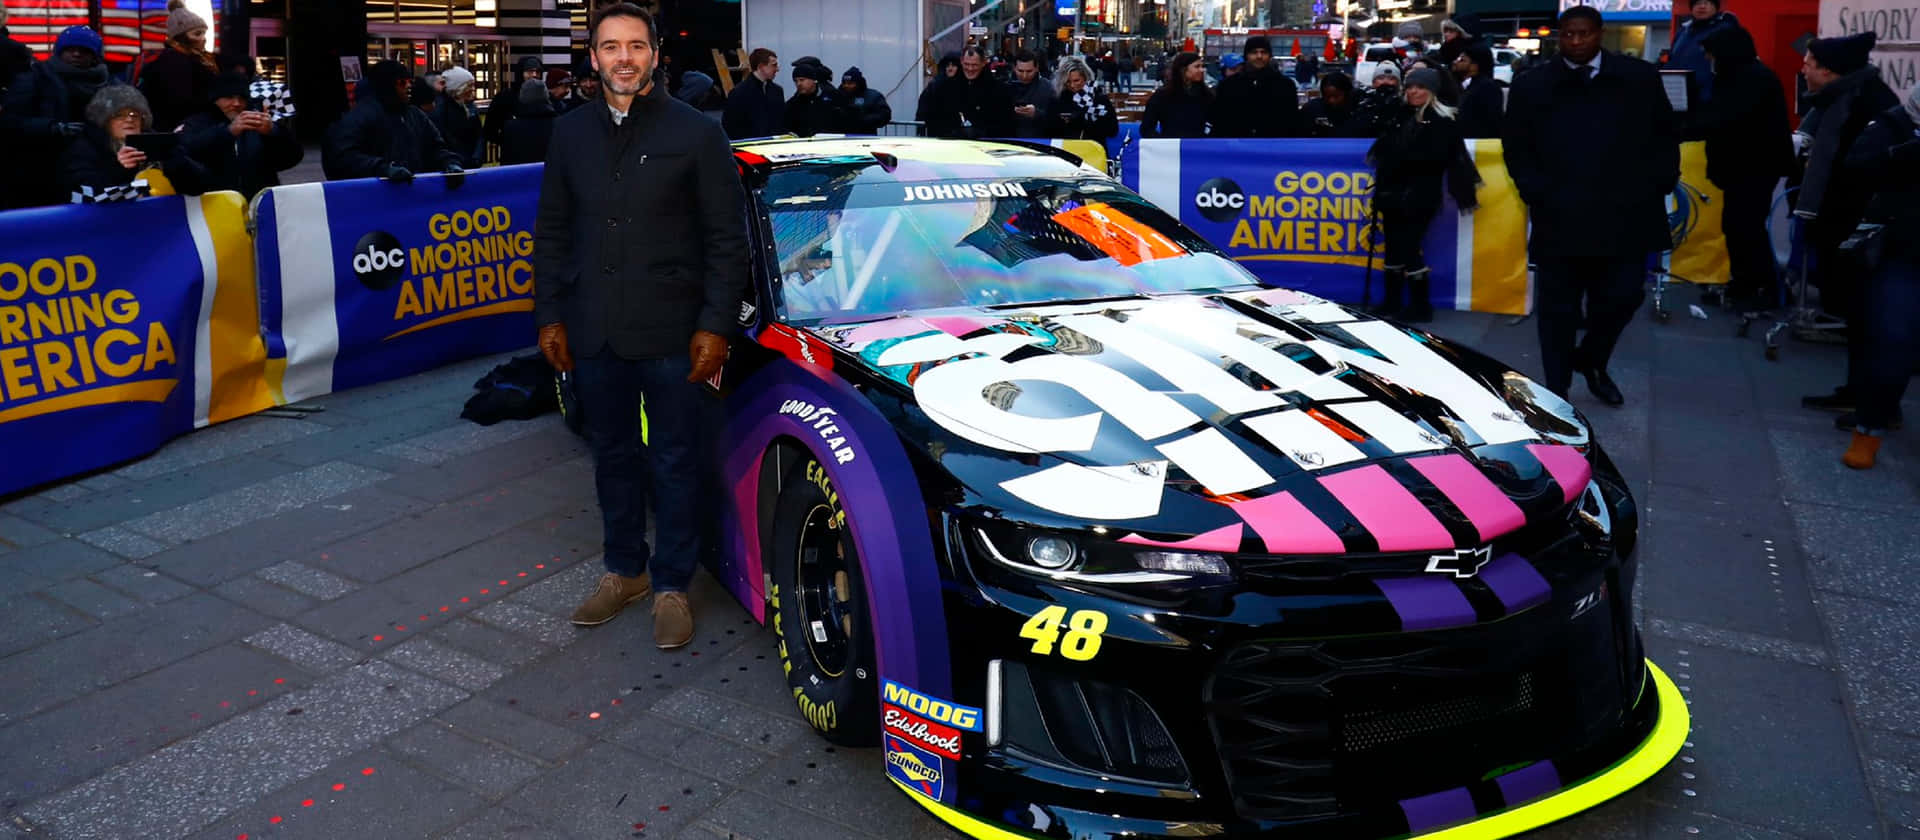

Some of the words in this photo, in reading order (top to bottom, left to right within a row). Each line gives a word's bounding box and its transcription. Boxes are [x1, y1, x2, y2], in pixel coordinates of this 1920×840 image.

[1839, 6, 1917, 40] SAVORY
[903, 182, 1028, 201] JOHNSON
[1196, 188, 1244, 208] abc
[1274, 171, 1375, 195] GOOD
[429, 206, 511, 241] GOOD
[1250, 195, 1384, 220] MORNIN
[353, 245, 405, 273] abc
[410, 231, 534, 275] MORNING
[394, 260, 536, 320] AMERIC
[0, 321, 176, 403] ERICA
[779, 399, 856, 465] GOODYEAR
[806, 460, 846, 530] EAGLE
[1019, 605, 1109, 661] 48
[884, 682, 978, 729] MOOG
[884, 710, 960, 753] Edelbrock
[890, 751, 938, 782] SUNOCO
